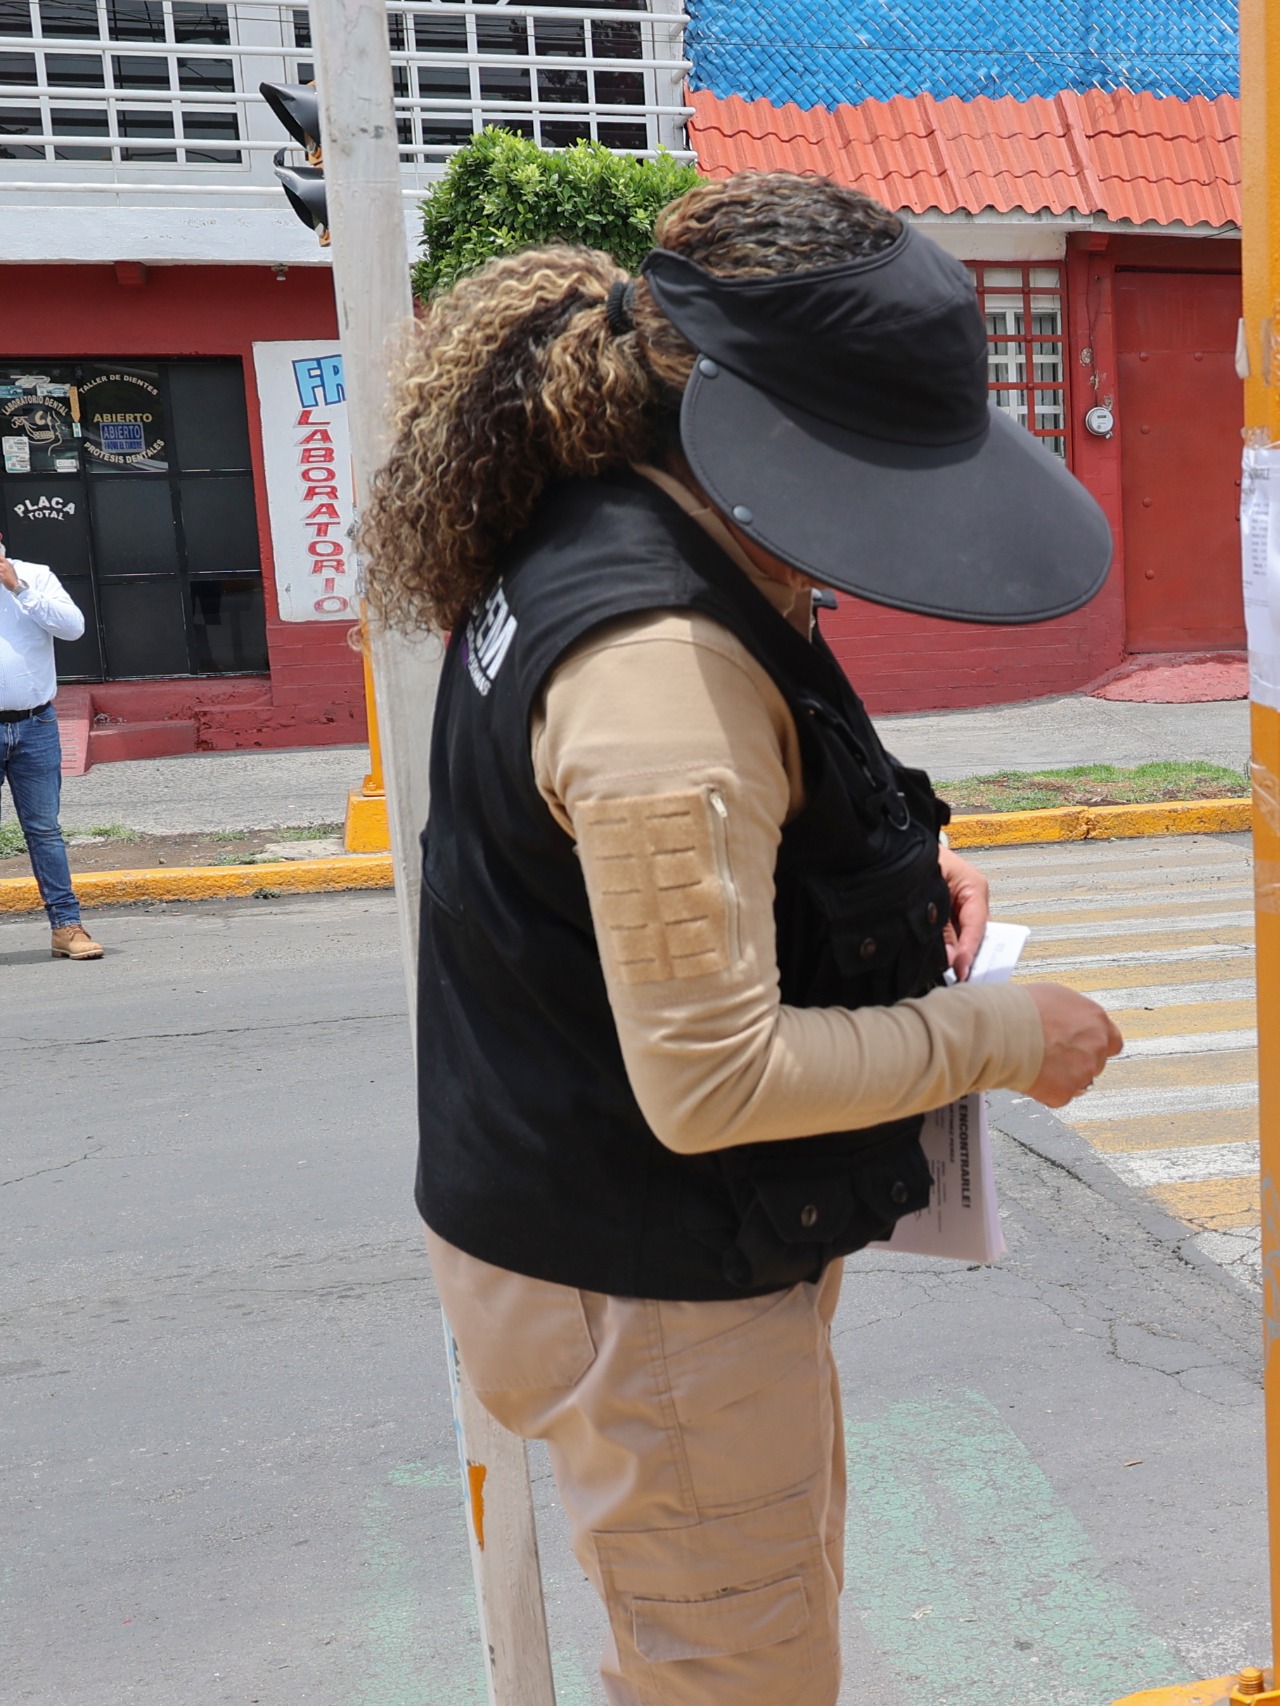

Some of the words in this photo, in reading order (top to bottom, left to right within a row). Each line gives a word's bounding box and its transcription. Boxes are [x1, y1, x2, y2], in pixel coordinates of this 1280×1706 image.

[79, 375, 108, 394] TALLER
[123, 374, 159, 396] DIENTES
[1, 395, 43, 416] LABORATORIO
[44, 397, 69, 416] DENTAL
[93, 413, 153, 423] ABIERTO
[103, 425, 141, 439] ABIERTO
[83, 441, 124, 463] PROTESIS
[125, 438, 165, 463] DENTALES
[13, 495, 76, 517] PLACA
[27, 510, 65, 521] TOTAL
[296, 409, 349, 614] LABORATORIO
[958, 1103, 971, 1210] ENCONTRARLE!
